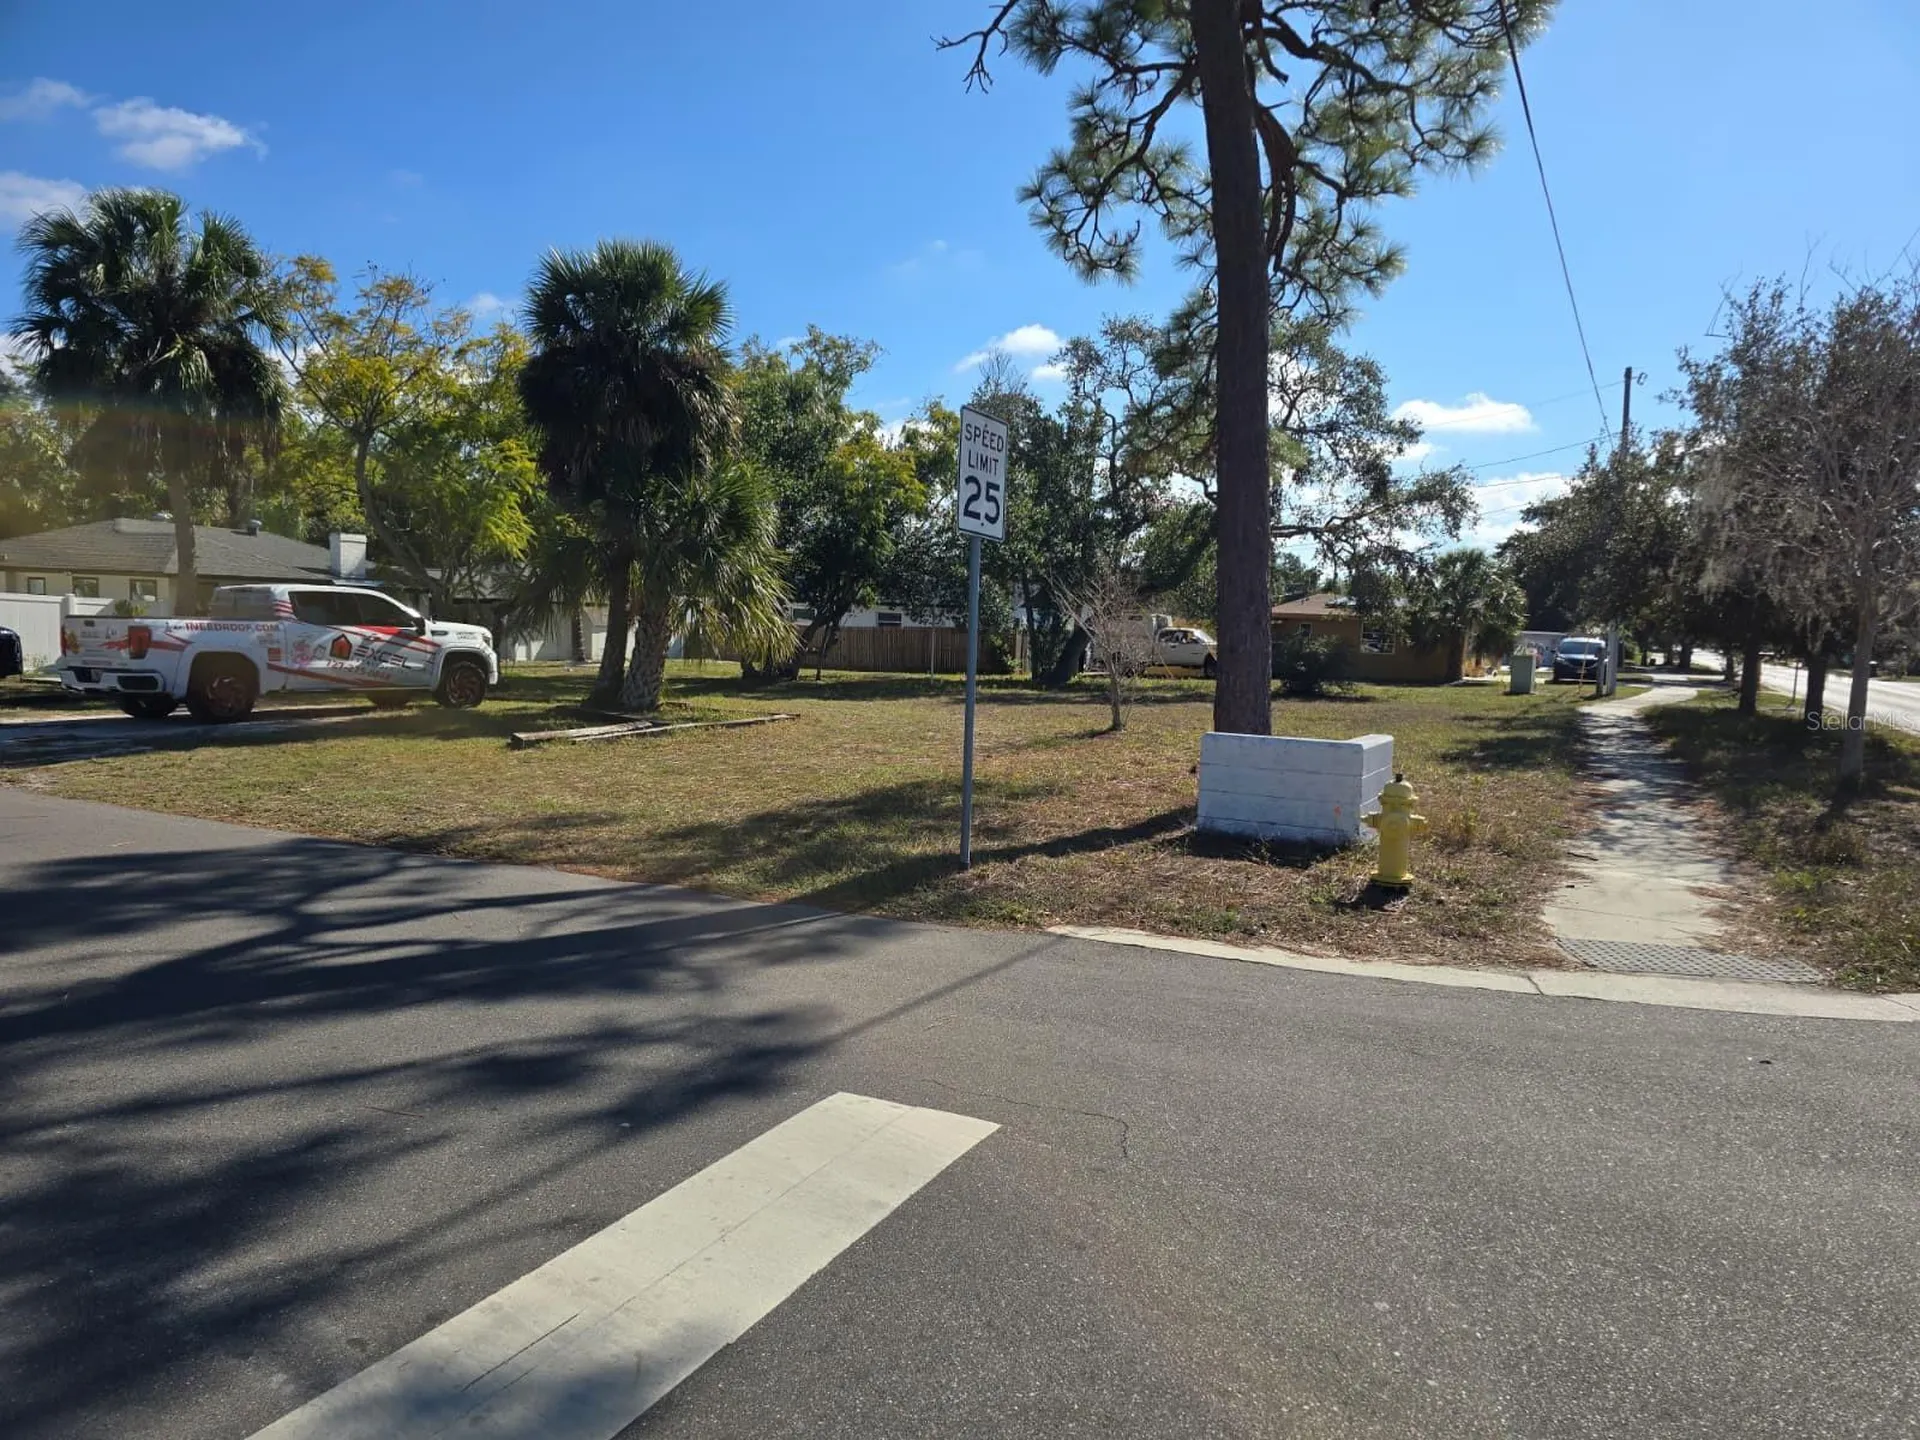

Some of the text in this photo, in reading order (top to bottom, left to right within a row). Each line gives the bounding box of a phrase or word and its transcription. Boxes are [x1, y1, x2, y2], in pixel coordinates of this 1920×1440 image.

[964, 422, 1004, 452] SPEED
[968, 450, 999, 476] LIMIT
[963, 475, 1001, 525] 25
[353, 646, 411, 669] EXCEL
